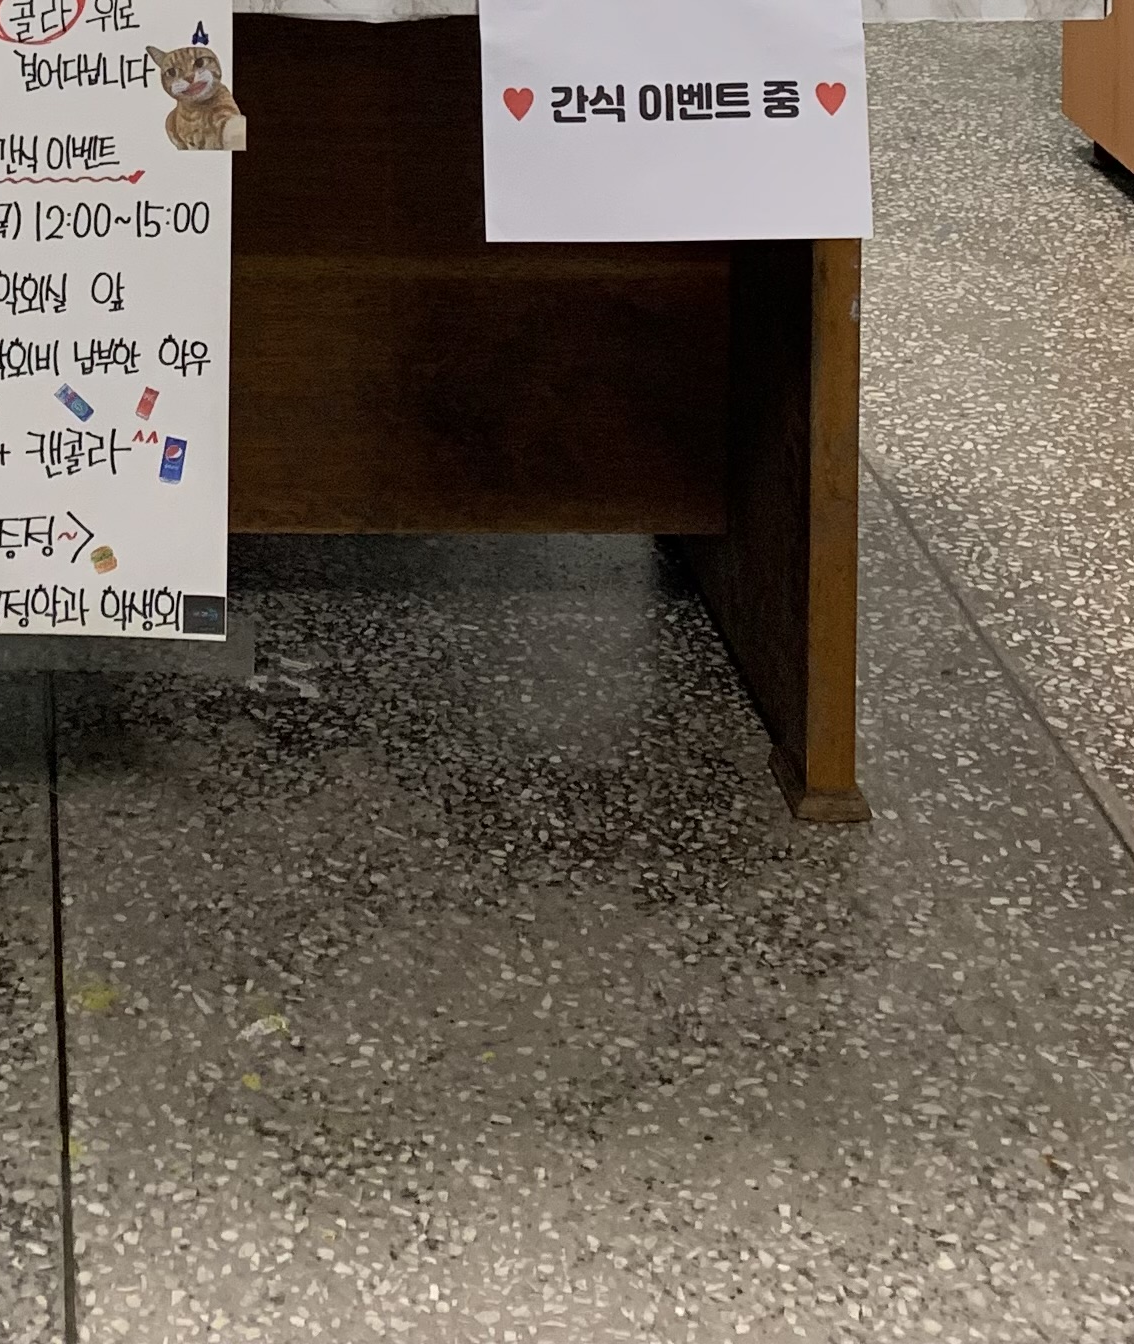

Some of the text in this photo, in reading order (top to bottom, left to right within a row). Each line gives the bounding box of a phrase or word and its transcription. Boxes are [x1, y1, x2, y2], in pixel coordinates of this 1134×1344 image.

[14, 49, 156, 93] 걸어다닙니다
[550, 80, 800, 123] 간식 이벤트 중
[46, 135, 121, 171] 이벤트
[35, 200, 210, 243] 12:00~15:00
[91, 271, 126, 313] 앞
[73, 337, 141, 376] 납부한
[158, 333, 211, 378] 학우
[100, 584, 184, 633] 학생회
